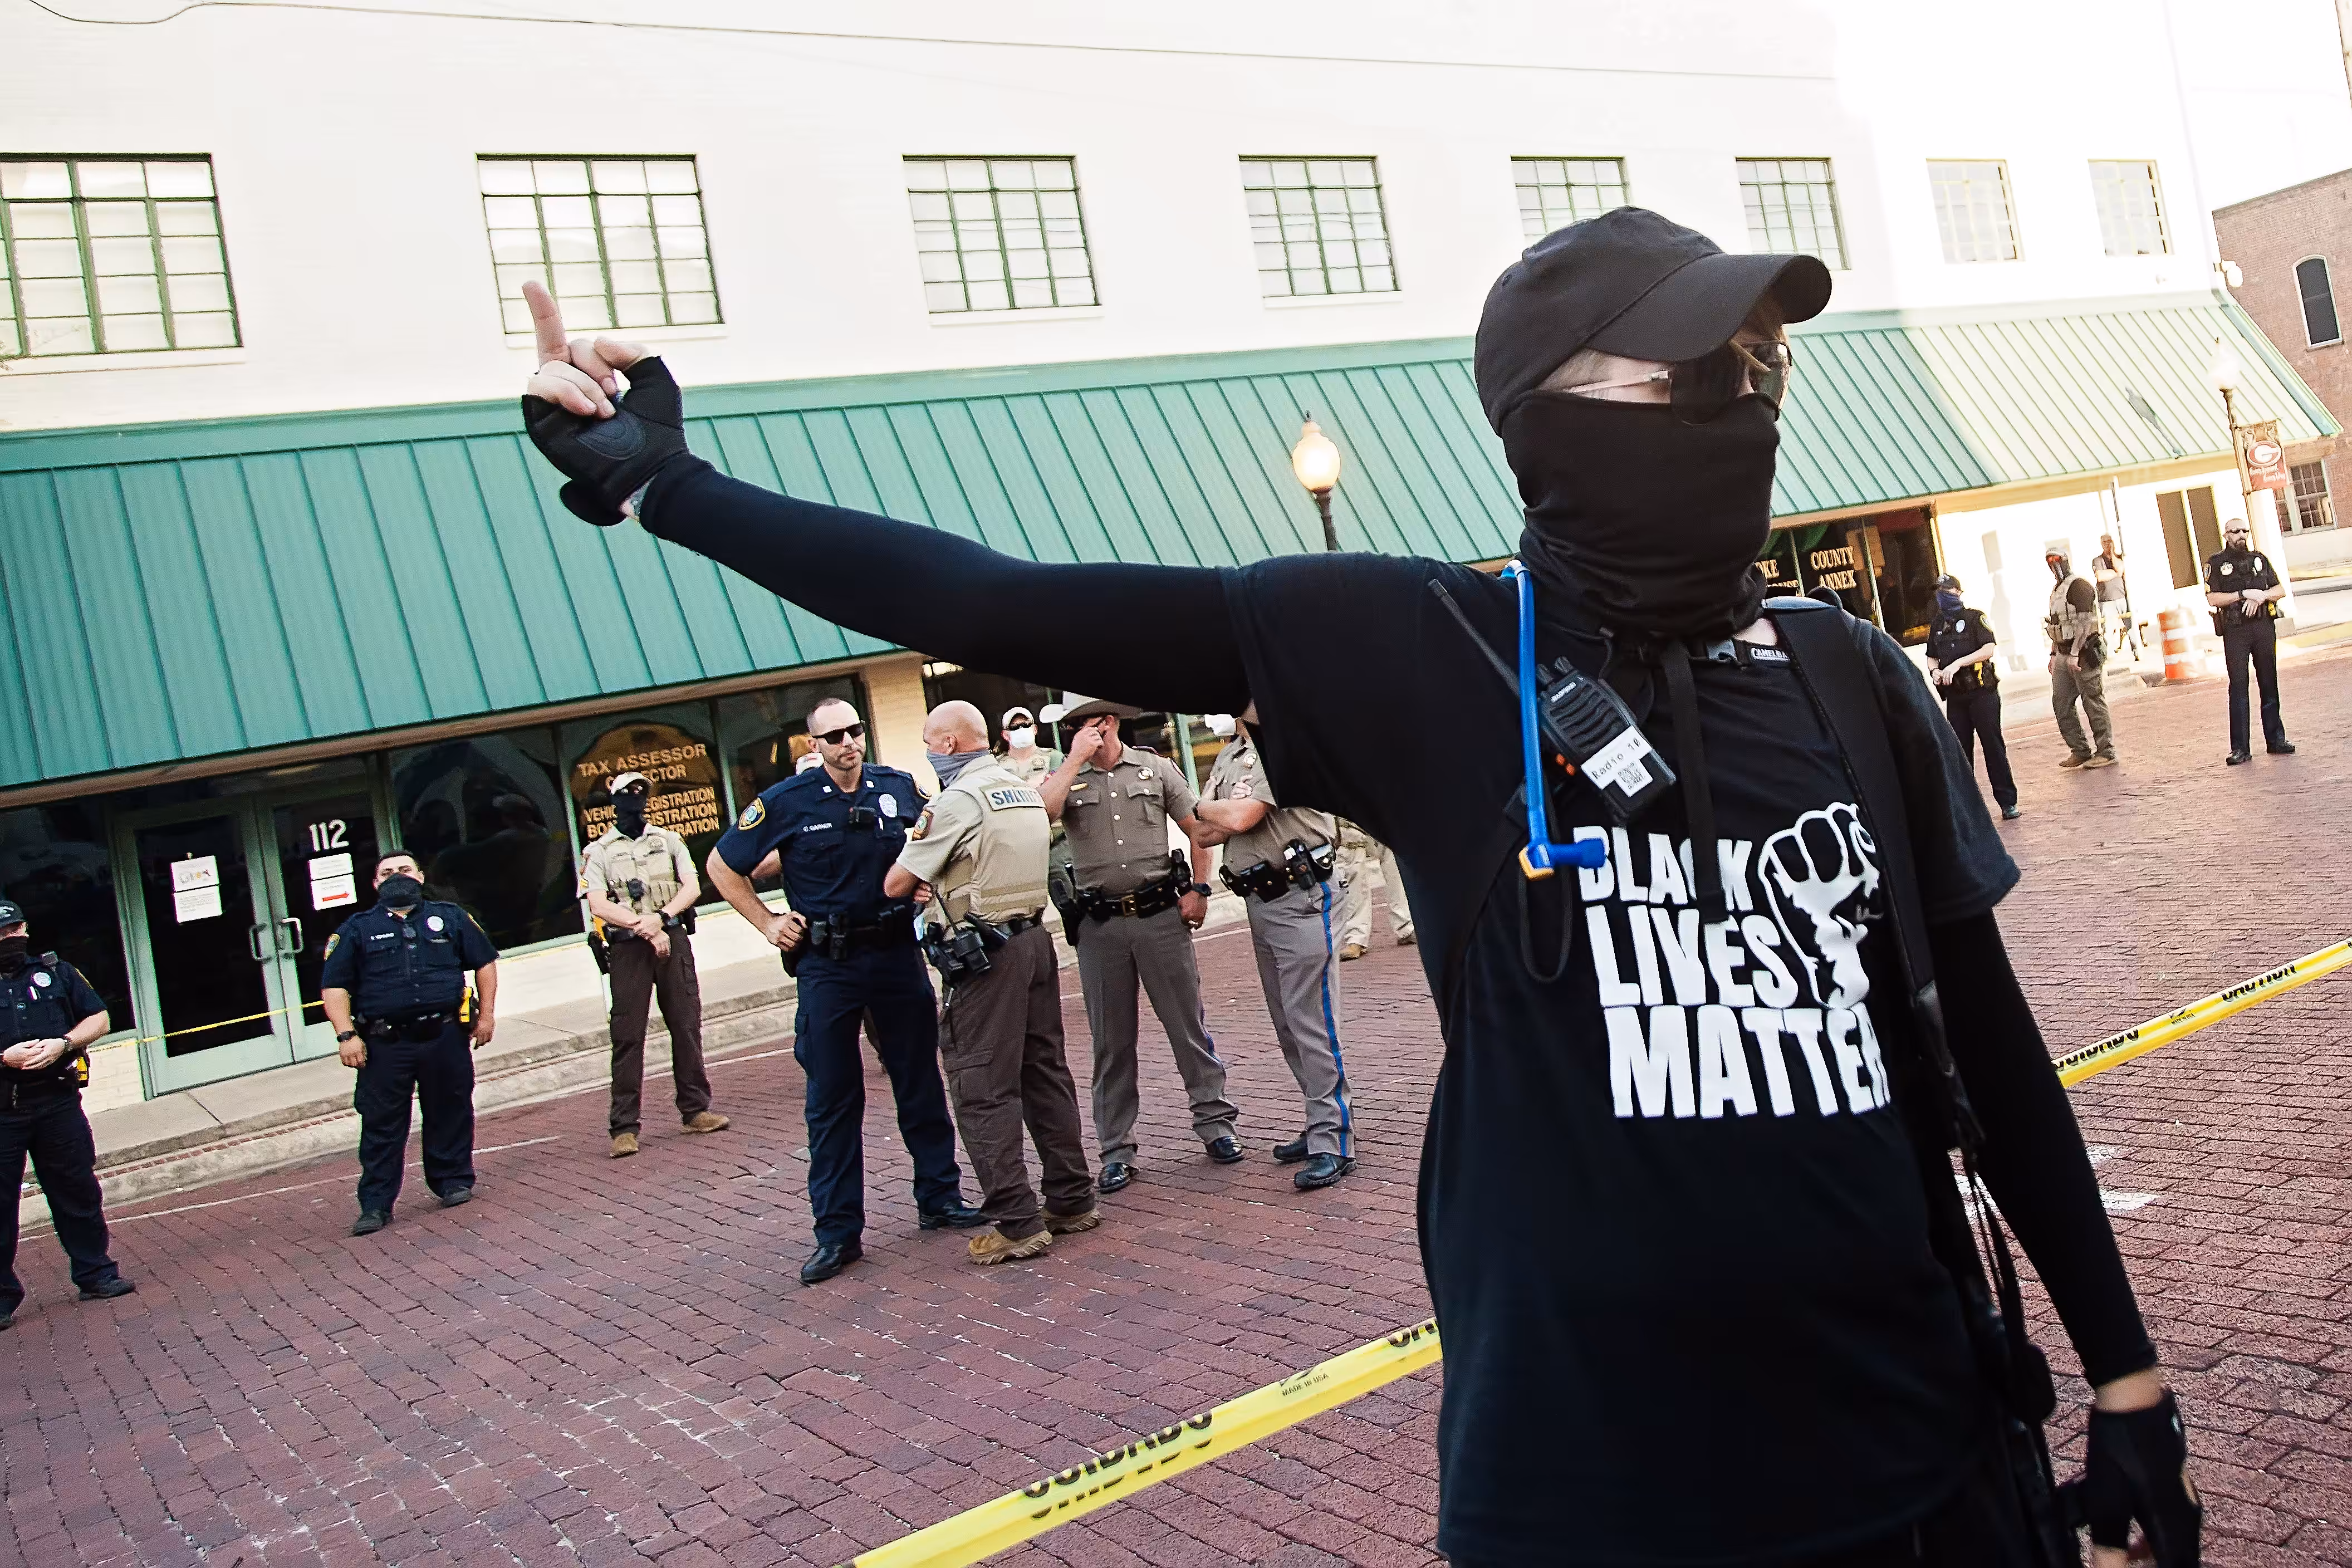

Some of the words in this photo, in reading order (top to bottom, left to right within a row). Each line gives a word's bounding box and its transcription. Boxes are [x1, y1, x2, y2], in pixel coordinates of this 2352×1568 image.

[1811, 546, 1854, 571] COUNTY
[1819, 569, 1856, 591] ANNEX
[1751, 648, 1790, 661] CAMELBA
[576, 761, 611, 778] TAX
[616, 743, 707, 771] ASSESSOR
[1591, 753, 1624, 780] Radio
[309, 819, 349, 852] 112
[1585, 904, 1799, 1009] LIVES
[1282, 1383, 1303, 1396] MADE
[1304, 1378, 1312, 1387] IN
[1313, 1373, 1330, 1383] USA
